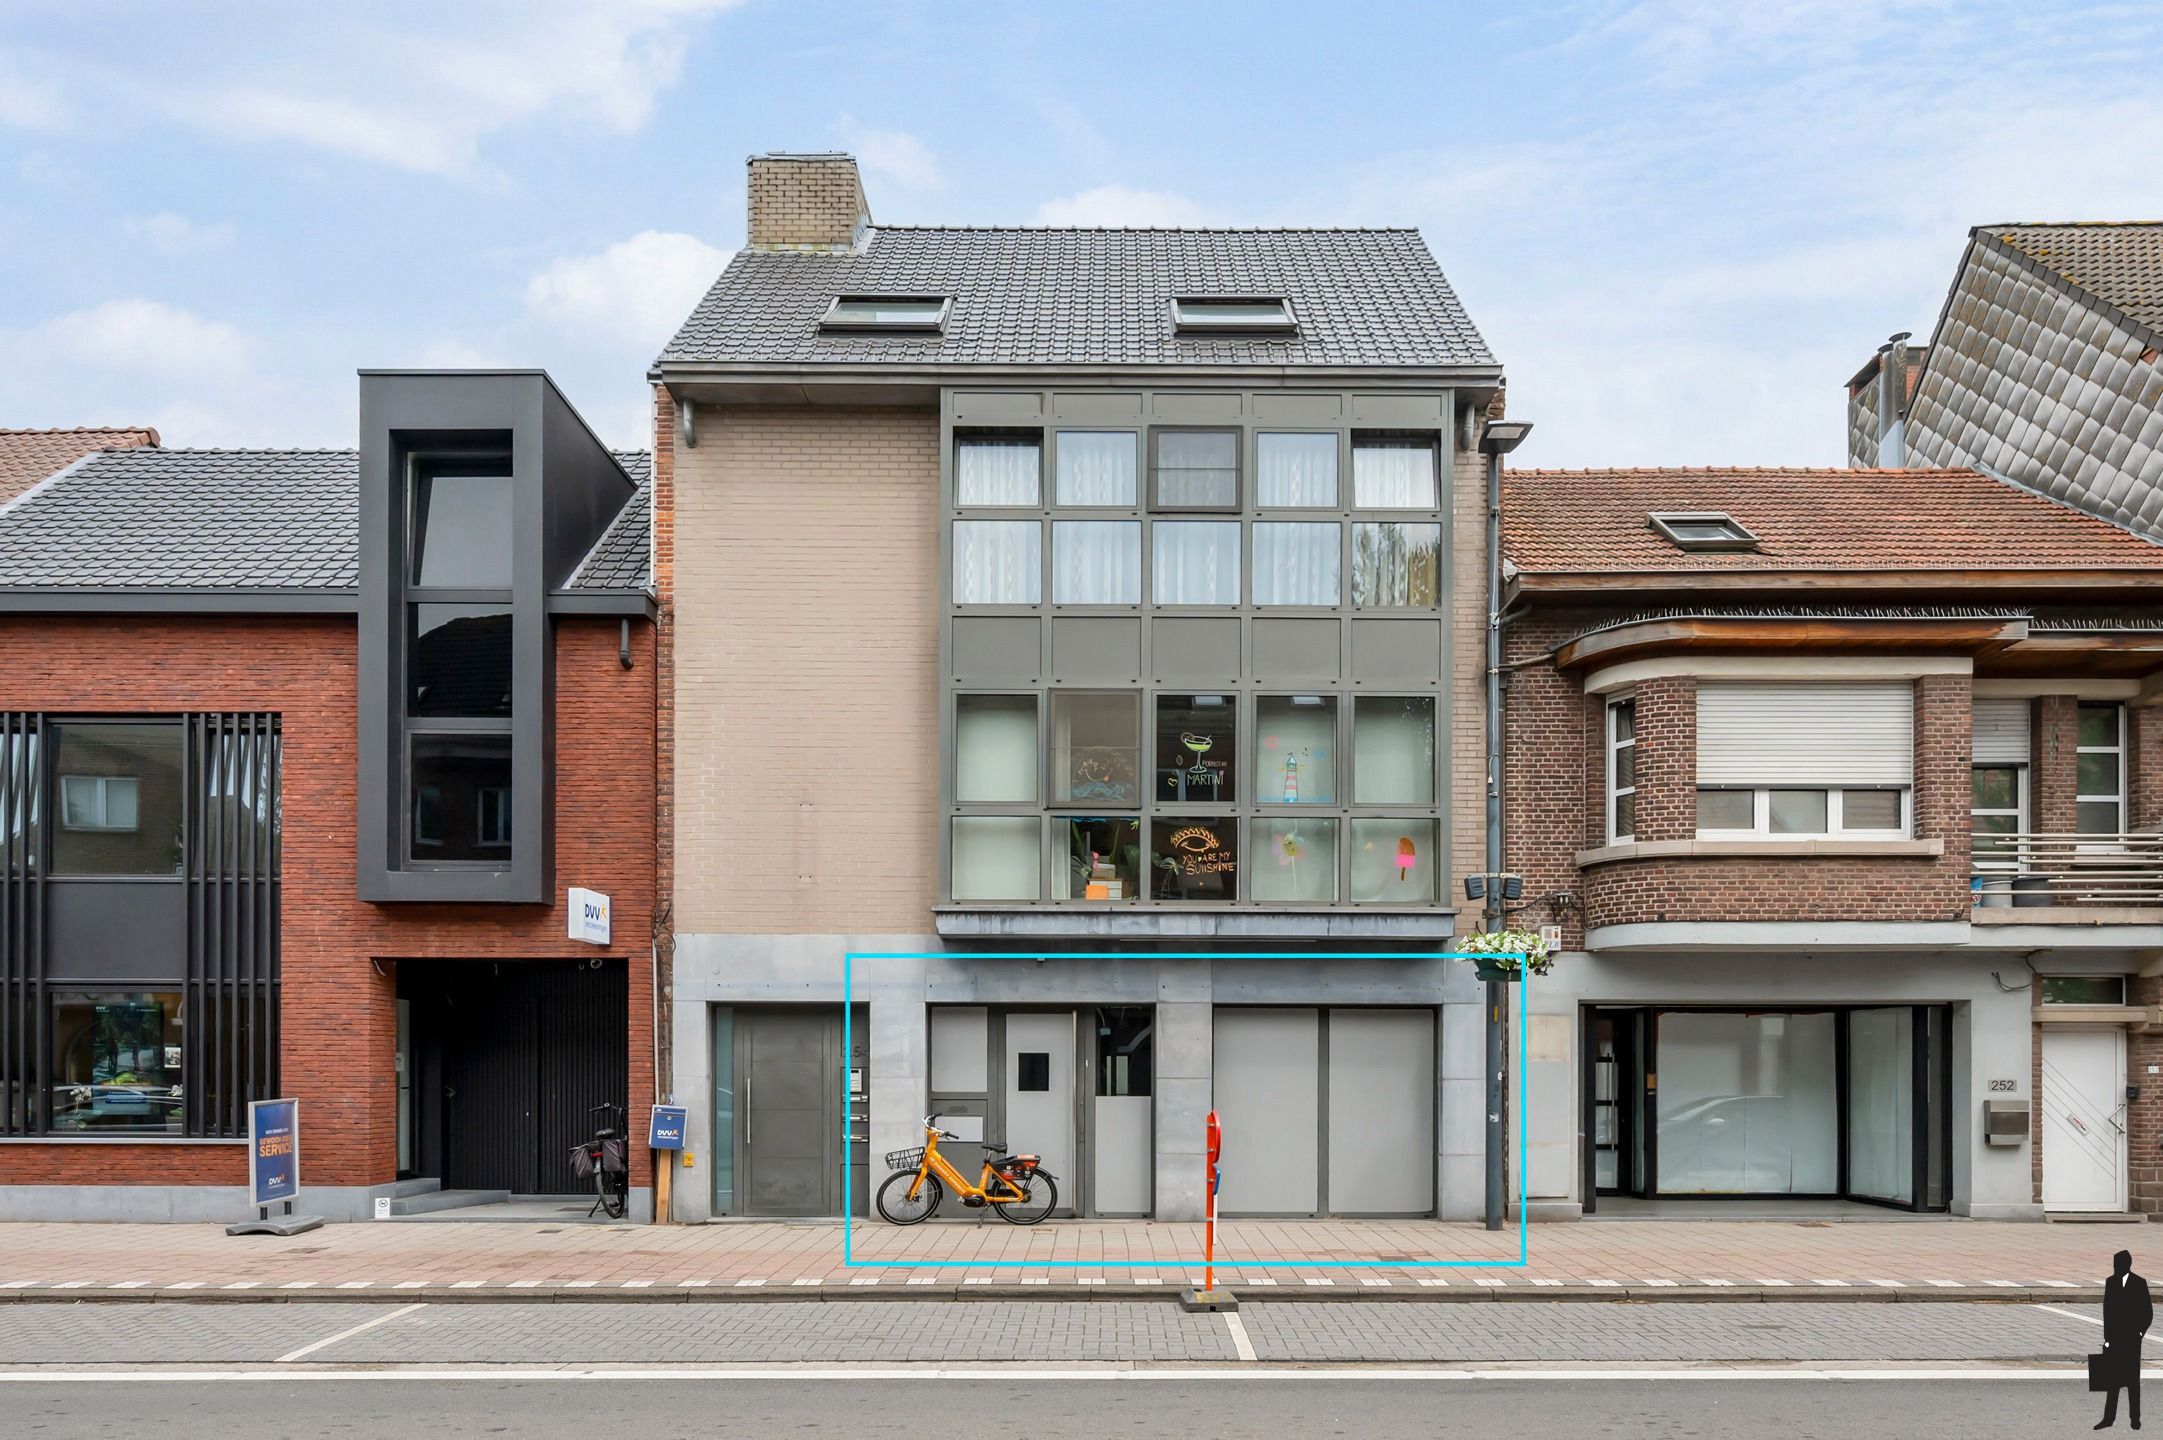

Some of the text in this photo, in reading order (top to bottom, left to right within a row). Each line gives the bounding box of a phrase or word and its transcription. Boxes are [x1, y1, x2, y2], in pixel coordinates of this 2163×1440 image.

[1186, 770, 1224, 786] MARTINI
[1183, 851, 1231, 865] YOU ARE MY
[585, 903, 600, 921] DVV
[1991, 1080, 2014, 1091] 252
[260, 1143, 292, 1157] SERVICE
